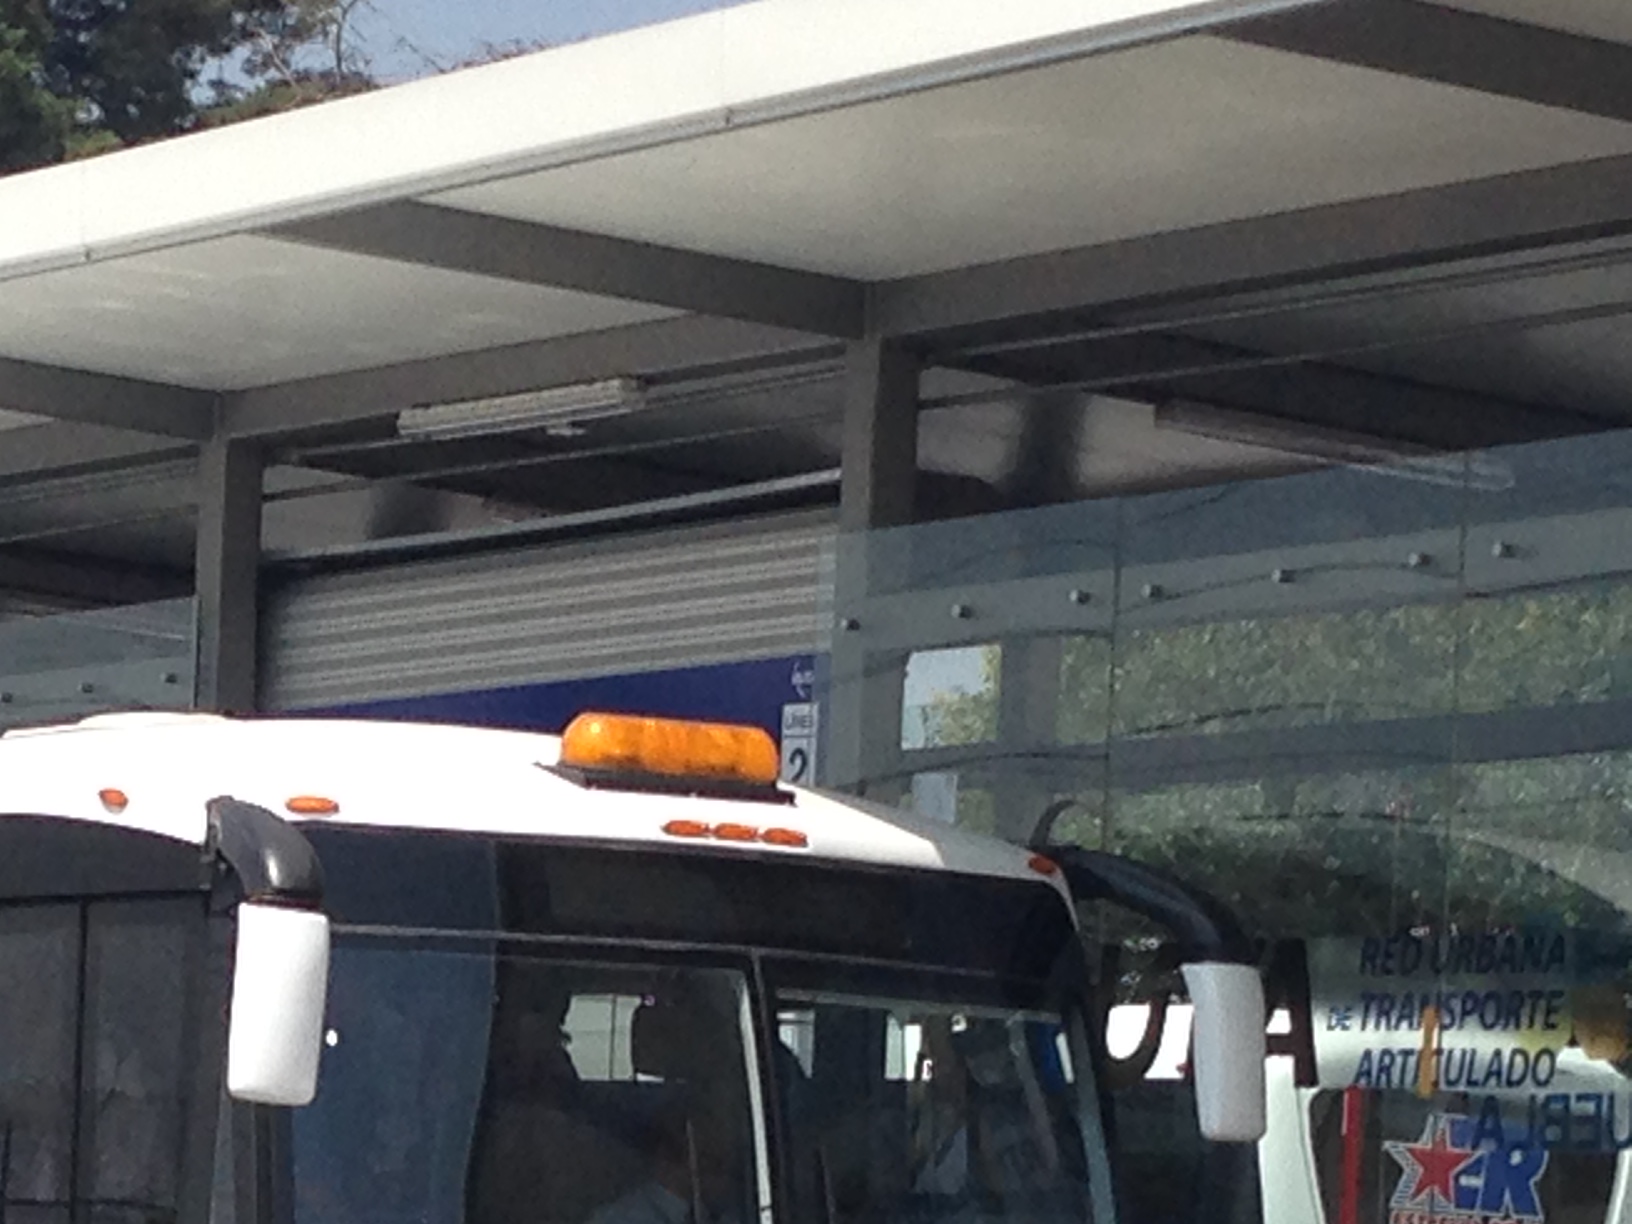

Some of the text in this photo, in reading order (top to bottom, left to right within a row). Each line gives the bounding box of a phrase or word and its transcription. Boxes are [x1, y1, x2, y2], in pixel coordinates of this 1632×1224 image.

[788, 747, 808, 782] 2
[1359, 933, 1566, 976] RED URBANA
[1326, 989, 1566, 1032] DE TRANSPORTE
